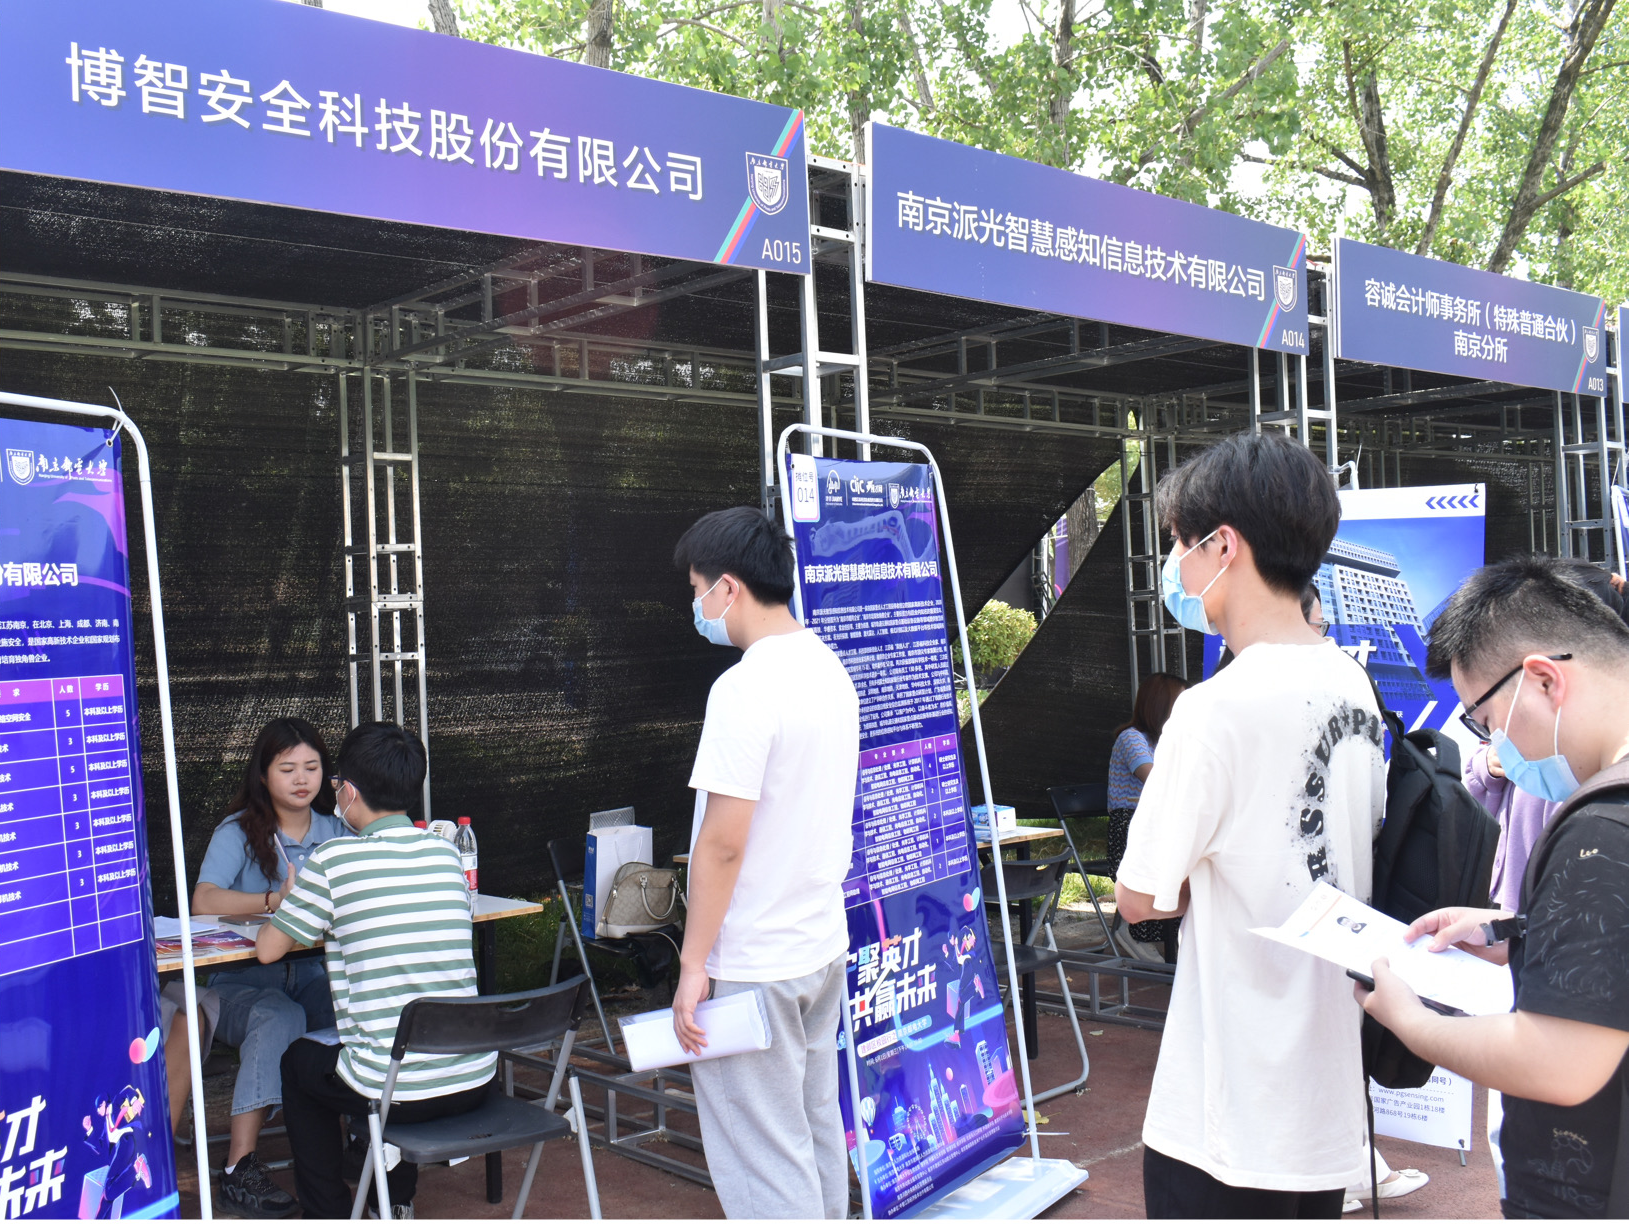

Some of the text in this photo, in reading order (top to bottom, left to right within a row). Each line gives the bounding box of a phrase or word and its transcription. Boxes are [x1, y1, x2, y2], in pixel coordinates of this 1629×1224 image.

[64, 42, 704, 202] 博智安全科技股份有限公司
[761, 238, 802, 264] A015
[896, 190, 1265, 301] 南京派光智慧感知信息技术有限公司
[1365, 277, 1576, 346] 容诚会计师事务所（特殊普通合伙）
[1281, 328, 1305, 349] A014
[1454, 329, 1508, 363] 南京分所
[1587, 376, 1604, 392] A013
[797, 487, 815, 503] 014
[804, 561, 938, 584] 南京派光智慧感知信息技术有限公司
[59, 685, 74, 694] 人数
[95, 682, 110, 692] 学历
[65, 709, 71, 717] 5
[84, 705, 123, 716] 本科及以上学历
[68, 737, 73, 746] 3
[86, 732, 126, 744] 本科及以上学历
[70, 765, 76, 774] 5
[88, 759, 128, 772] 本科及以上学历
[72, 793, 78, 802] 3
[91, 786, 130, 800] 本科及以上学历
[75, 821, 80, 830] 3
[93, 813, 132, 827] 本科及以上学历
[77, 850, 82, 858] 3
[95, 841, 134, 855] 本科及以上学历
[79, 878, 85, 887] 3
[97, 868, 136, 884] 本科及以上学历
[849, 962, 938, 1033] 共赢未来
[1378, 1088, 1444, 1103] www.pgsensing.com
[1371, 1095, 1446, 1114] 国家广告产业园1栋18楼
